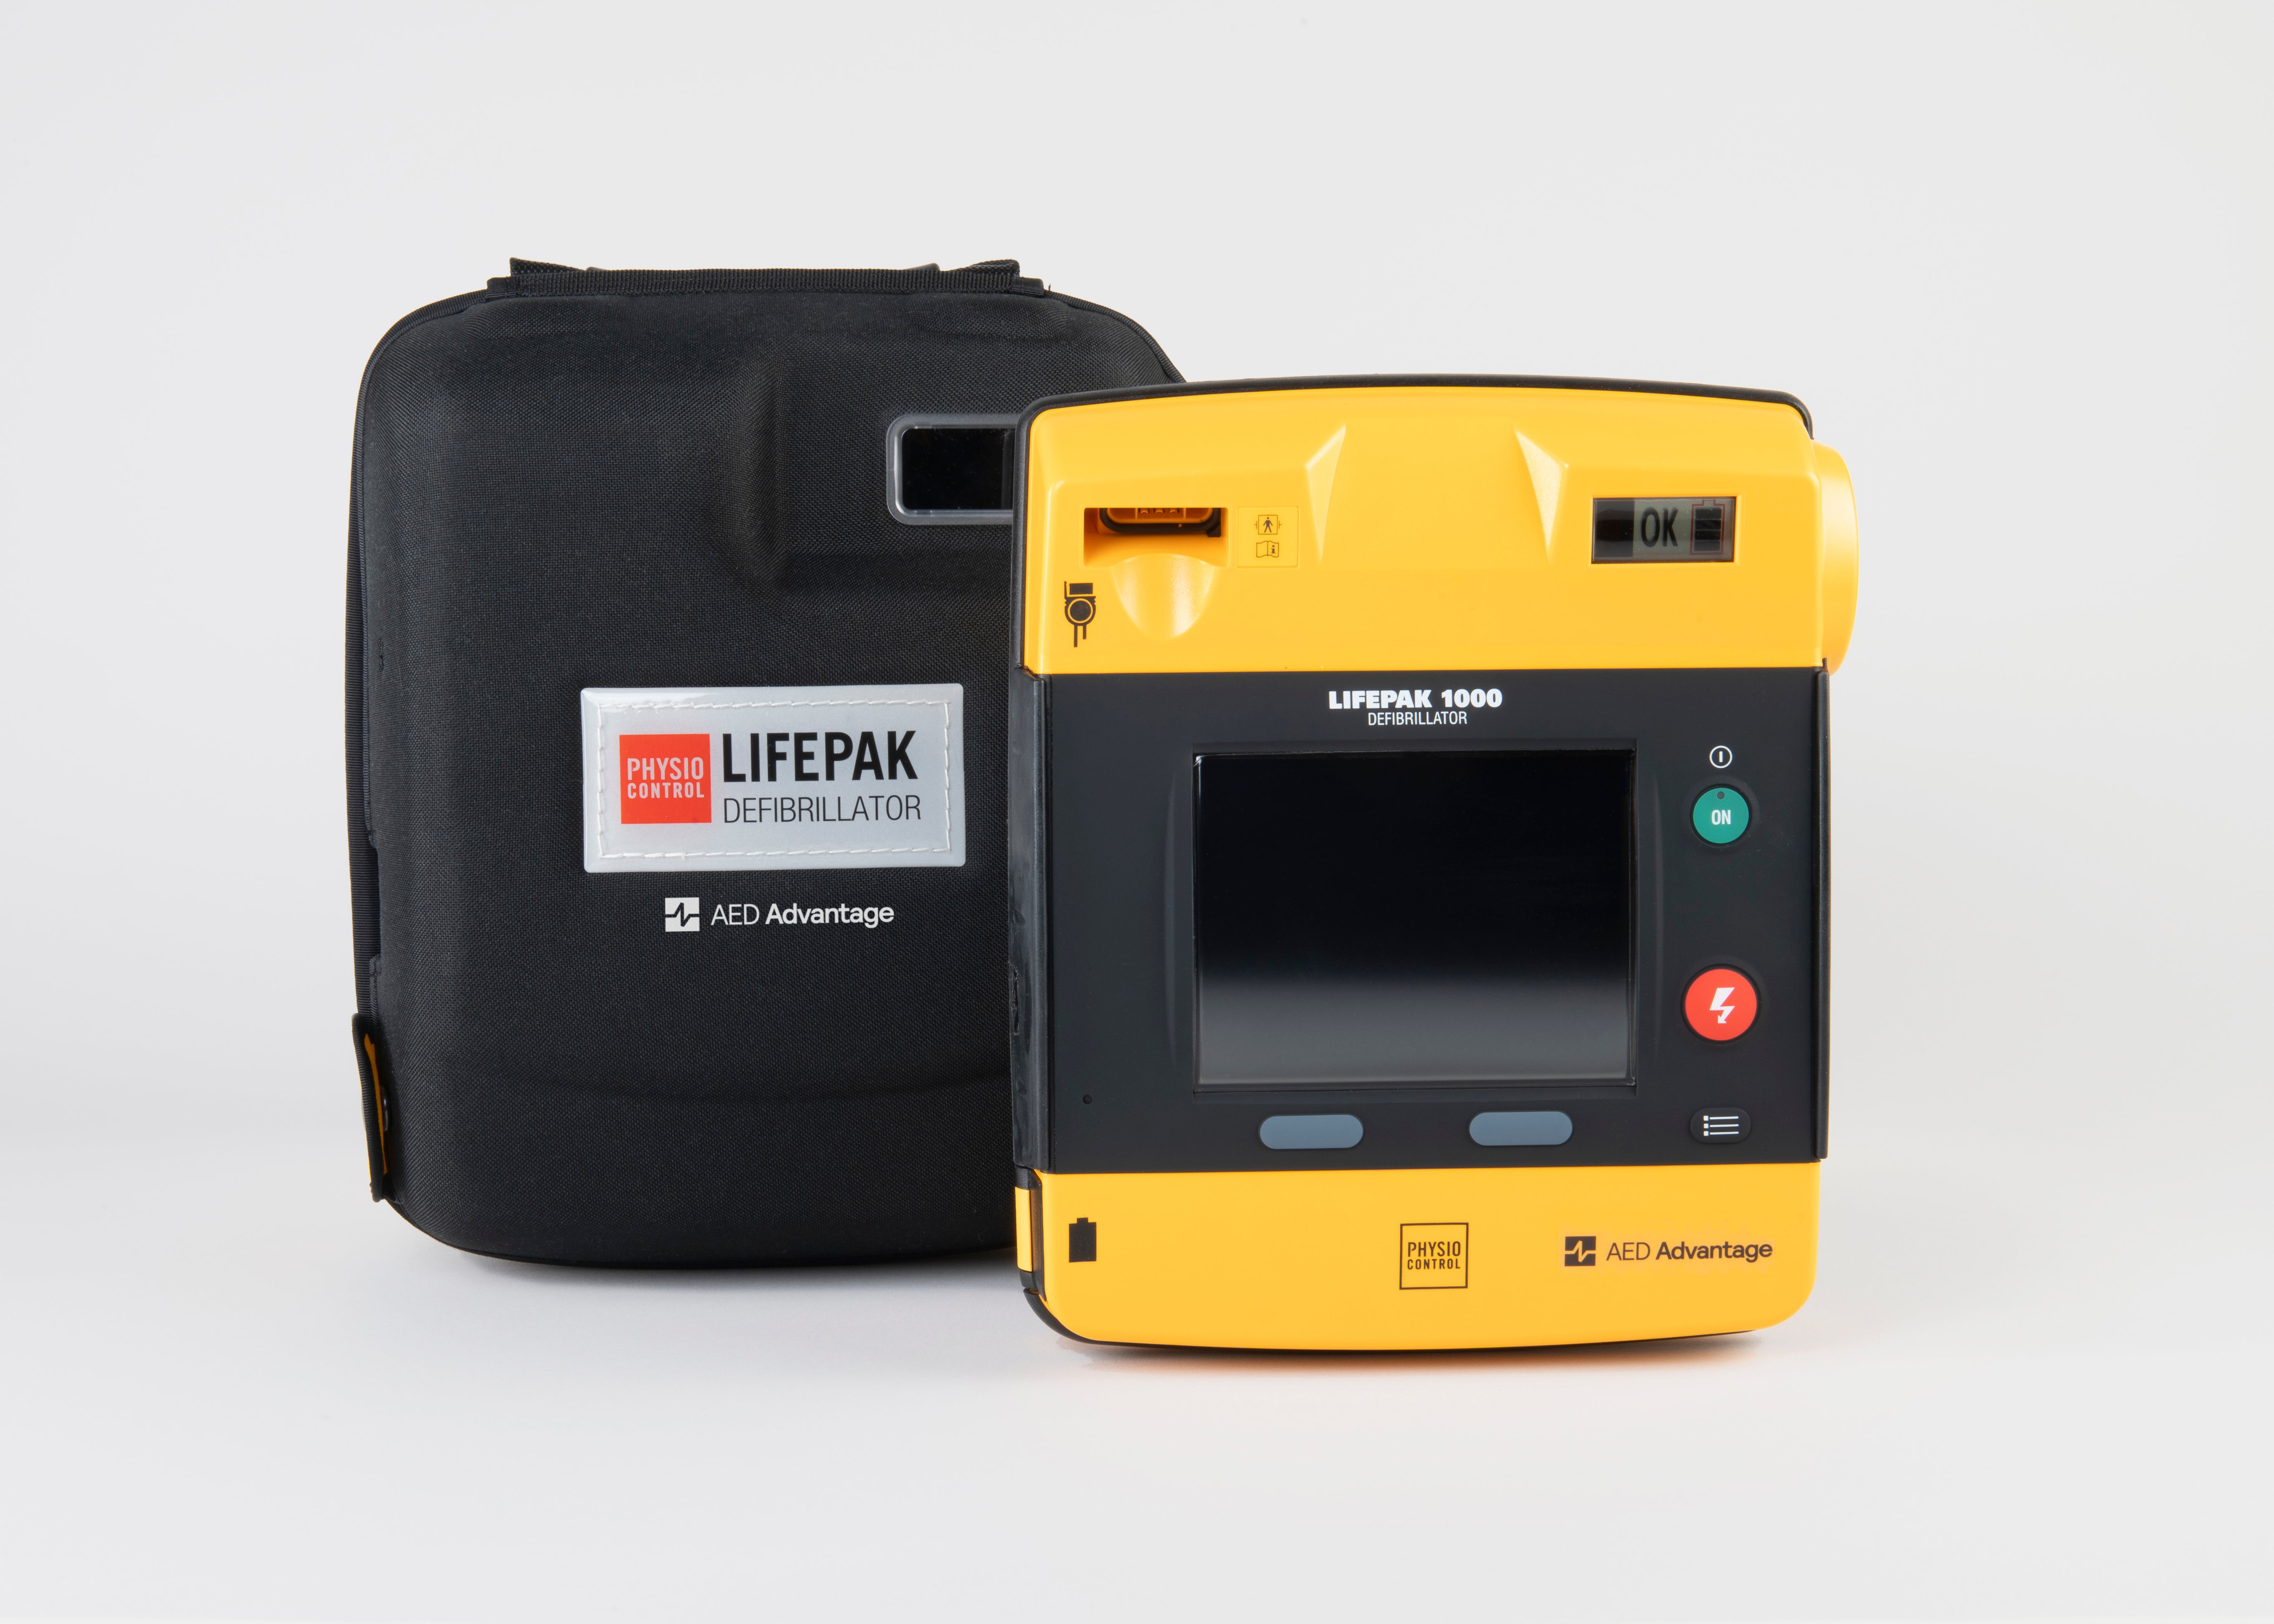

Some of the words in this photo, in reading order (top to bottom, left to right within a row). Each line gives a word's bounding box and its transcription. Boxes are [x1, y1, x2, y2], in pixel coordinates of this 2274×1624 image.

[1641, 507, 1678, 547] OK
[1329, 690, 1432, 709] LIFEPAK
[1441, 688, 1502, 708] 1000
[1368, 711, 1467, 726] DEFIBRILLATOR
[722, 730, 918, 782] LIFEPAK
[627, 757, 704, 780] PHYSIO
[627, 782, 704, 799] CONTROL
[724, 795, 921, 823] DEFIBRILLATOR
[1711, 809, 1731, 825] ON
[711, 904, 759, 925] AED
[765, 903, 894, 928] Advantage
[1407, 1241, 1461, 1257] PHYSIO
[1606, 1242, 1650, 1260] AED
[1655, 1240, 1773, 1262] Advantage
[1407, 1259, 1461, 1270] CONTROL
